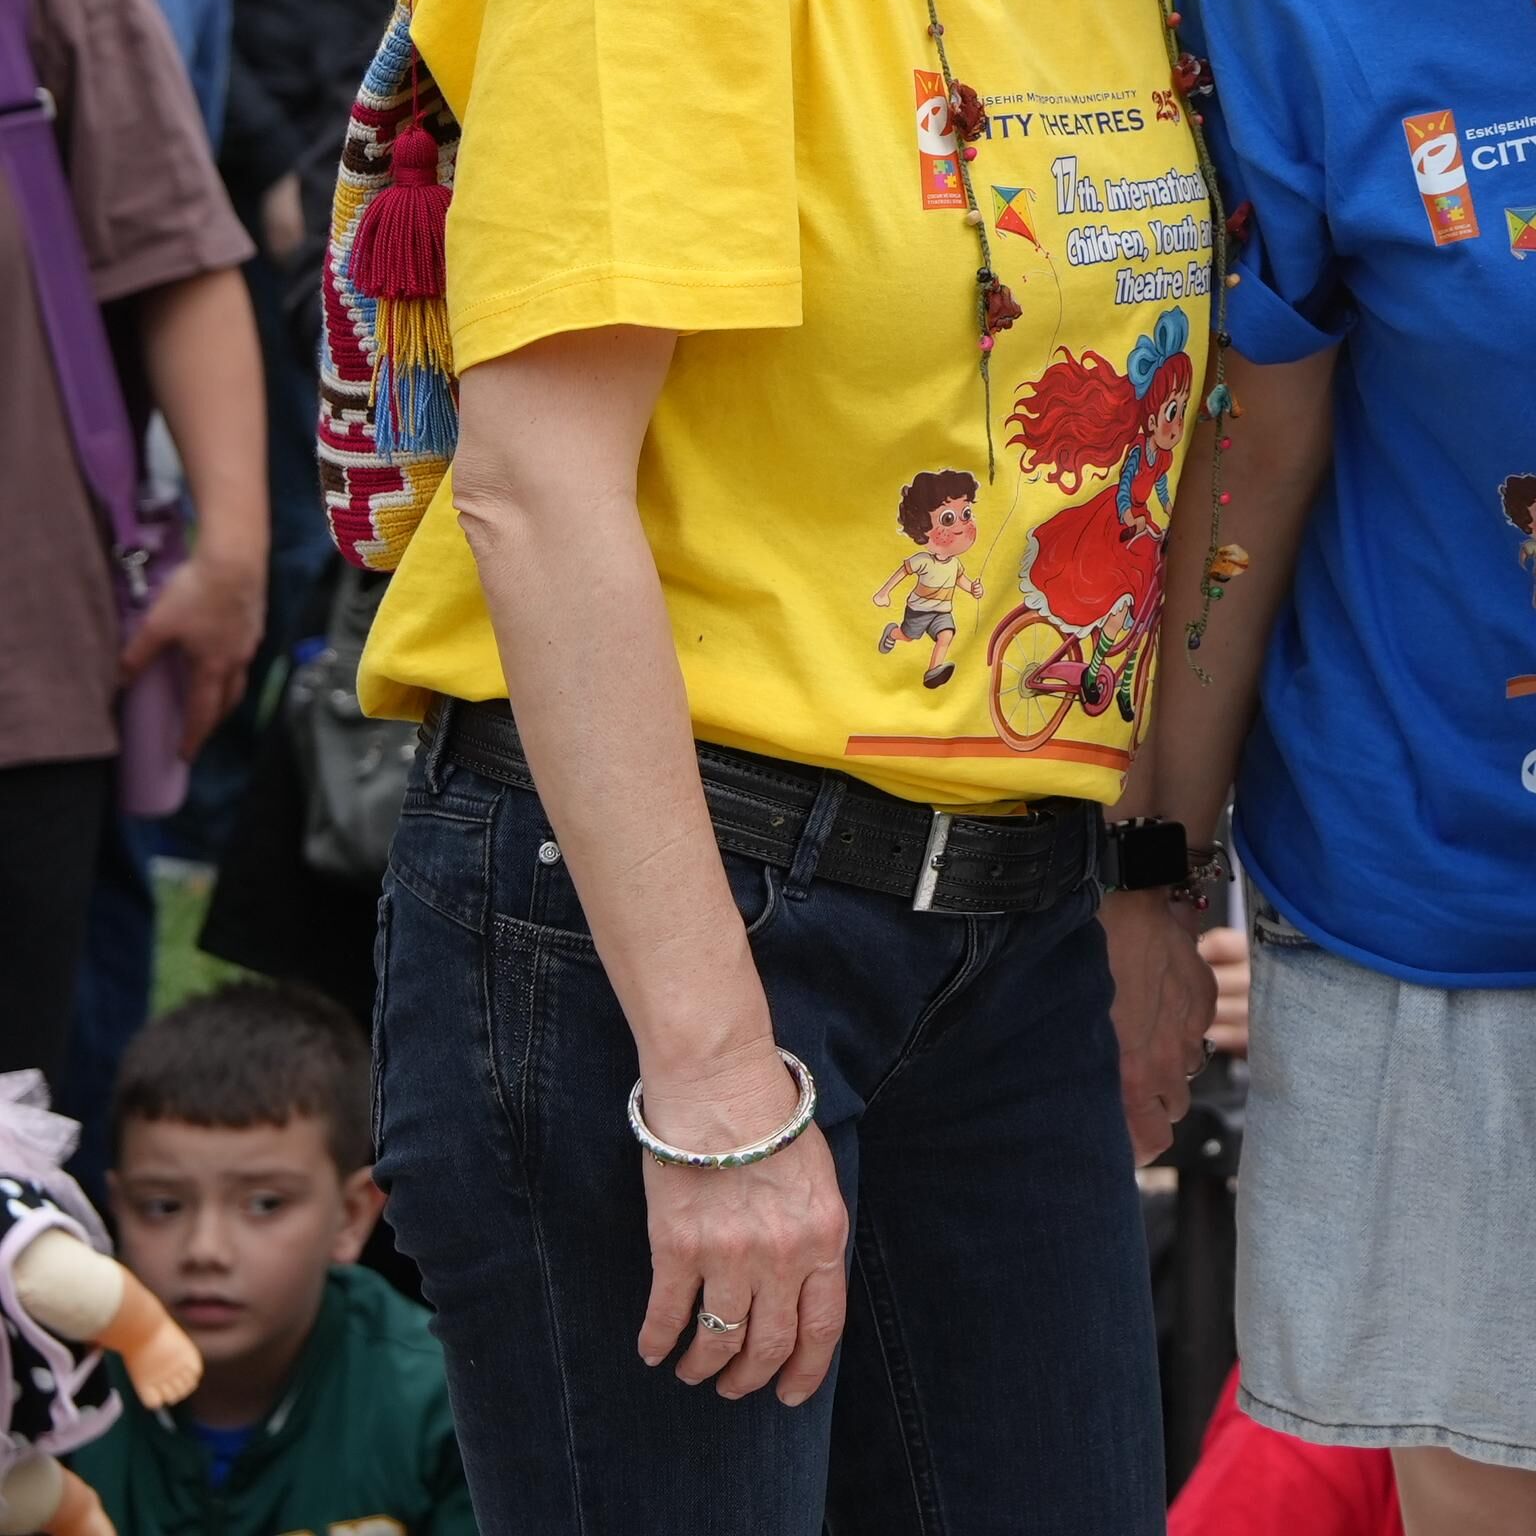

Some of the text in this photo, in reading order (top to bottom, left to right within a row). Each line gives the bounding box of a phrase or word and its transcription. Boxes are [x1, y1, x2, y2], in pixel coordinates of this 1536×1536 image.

[1071, 89, 1138, 105] MUNICIPALITY
[984, 108, 1145, 140] ITY THEATRES
[1051, 156, 1104, 215] 17th.
[1066, 224, 1150, 266] Children,
[1148, 214, 1198, 255] Youth
[1115, 267, 1184, 305] Theatre
